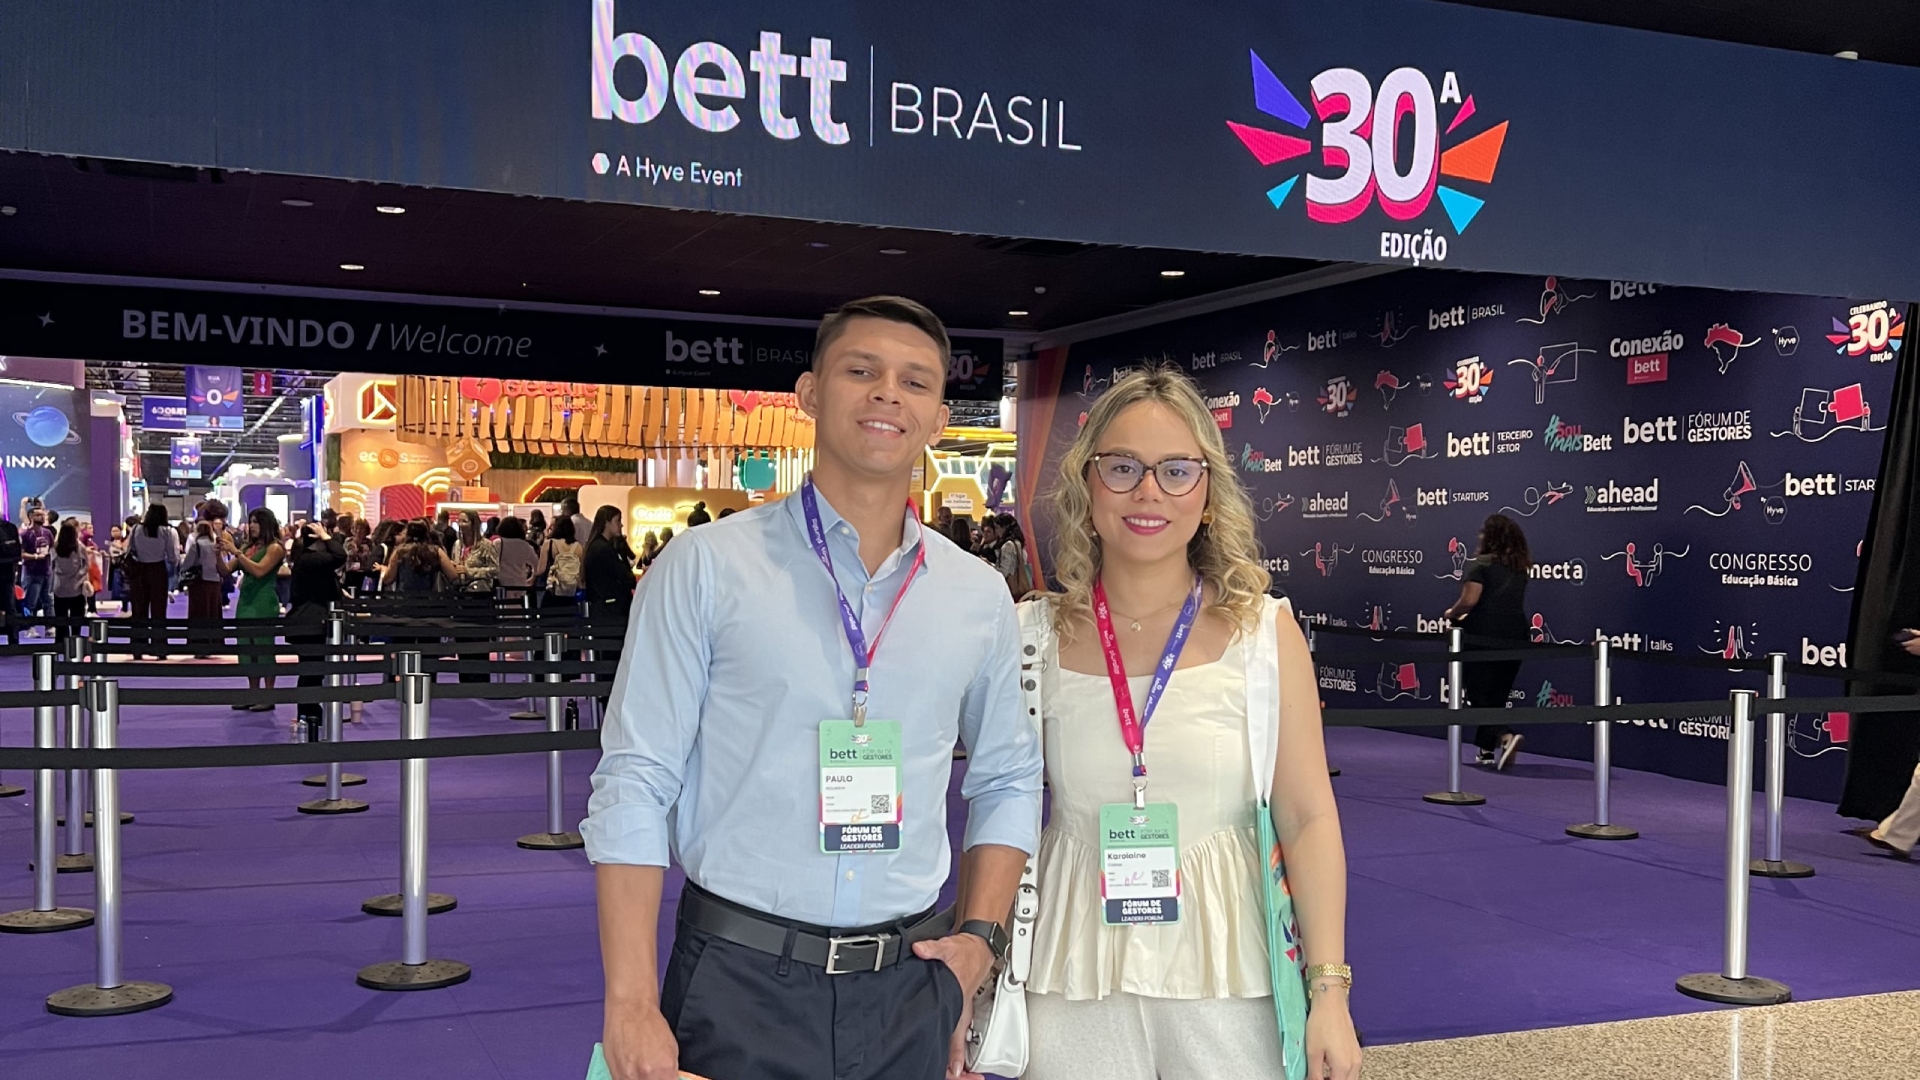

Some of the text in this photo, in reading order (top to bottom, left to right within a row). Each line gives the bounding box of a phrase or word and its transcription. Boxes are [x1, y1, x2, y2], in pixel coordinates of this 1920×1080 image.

[591, 0, 1082, 151] bett BRASIL
[616, 154, 743, 187] A Hyve Event
[1380, 228, 1447, 266] EDIÇÃO
[1428, 304, 1505, 330] bett BRASIL
[122, 308, 355, 350] BEM-VINDO
[389, 322, 533, 359] Welcome
[1308, 330, 1337, 351] bett
[1778, 336, 1796, 347] Hyve
[665, 330, 810, 365] bett BRASI
[1610, 329, 1684, 358] Conexão
[1192, 351, 1242, 370] bett BRASIL
[1634, 359, 1660, 374] bett
[1623, 410, 1751, 444] bett FÓRUM DE
[1687, 425, 1752, 443] GESTORES
[1447, 429, 1534, 457] bett TERCEIRO
[1497, 442, 1521, 454] SETOR
[1288, 441, 1362, 467] bett FÓRUM DE
[1325, 453, 1363, 467] GESTORES
[1597, 478, 1658, 504] ahead
[1785, 473, 1876, 496] bett STAR
[1309, 491, 1348, 511] ahead
[1417, 487, 1489, 506] bett STARTUPS
[1767, 506, 1784, 516] Hyve
[1361, 550, 1423, 564] CONGRESSO
[1709, 552, 1812, 572] CONGRESSO
[1369, 565, 1395, 576] Educação
[1527, 561, 1583, 579] necta
[1721, 573, 1799, 588] Educação Básica
[1332, 618, 1347, 627] talks
[1650, 640, 1673, 651] talks
[1801, 637, 1847, 668] bet
[1319, 666, 1356, 680] FÓRUM DE
[1319, 678, 1356, 692] GESTORES
[1678, 720, 1730, 740] GESTOR
[830, 748, 858, 760] bett
[825, 775, 853, 783] PAULO
[841, 825, 882, 834] FÓRUM DE
[841, 834, 883, 843] GESTORES
[1109, 829, 1135, 839] bett
[840, 842, 863, 850] LEADERS
[1122, 899, 1161, 908] FÓRUM DE
[1122, 907, 1162, 915] GESTORES
